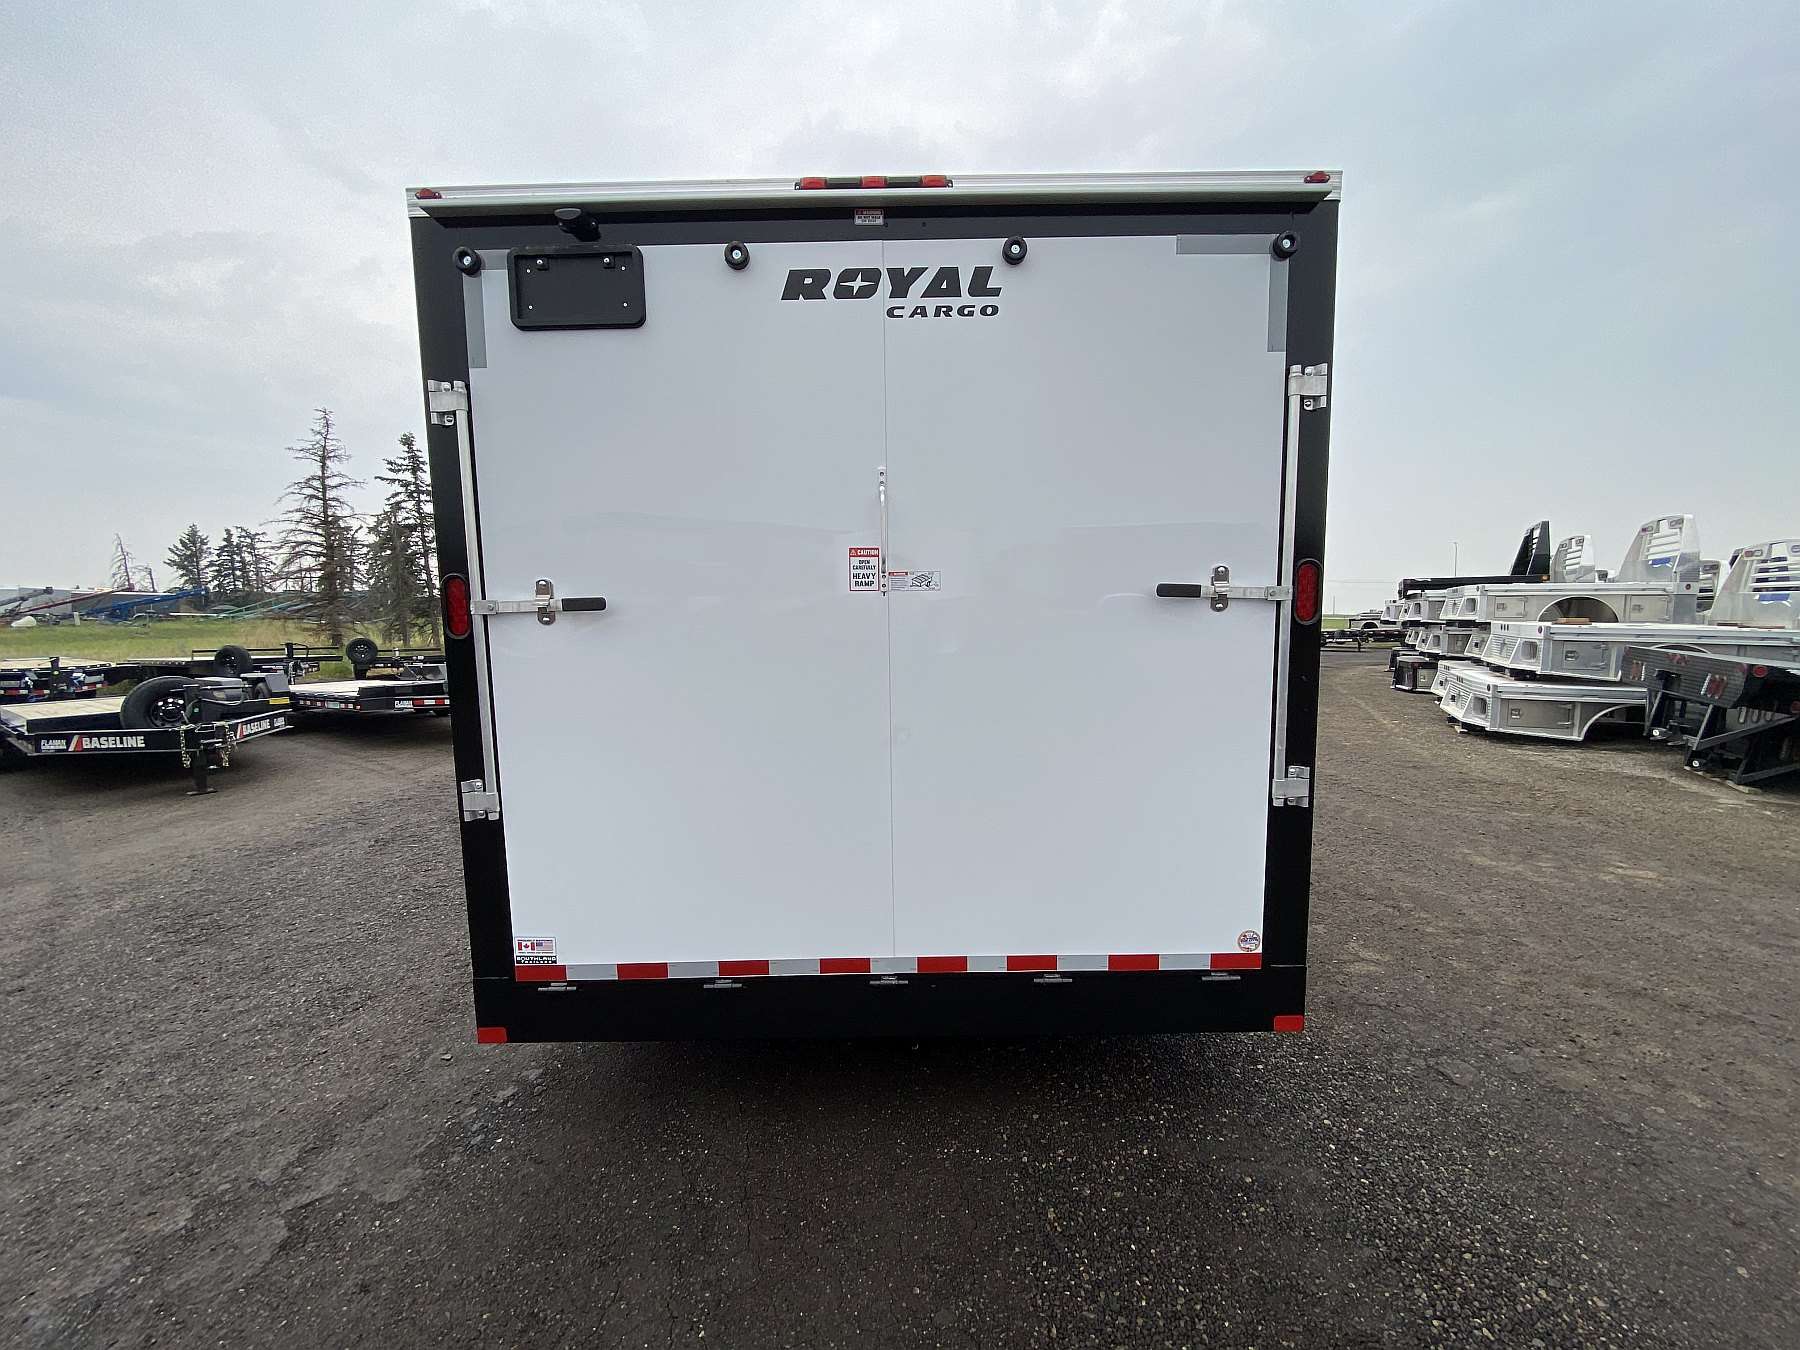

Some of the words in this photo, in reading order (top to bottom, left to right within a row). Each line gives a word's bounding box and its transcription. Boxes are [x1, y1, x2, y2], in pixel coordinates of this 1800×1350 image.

[781, 266, 1002, 300] ROYAL
[886, 304, 999, 318] CARGO
[82, 736, 146, 749] BASELINE
